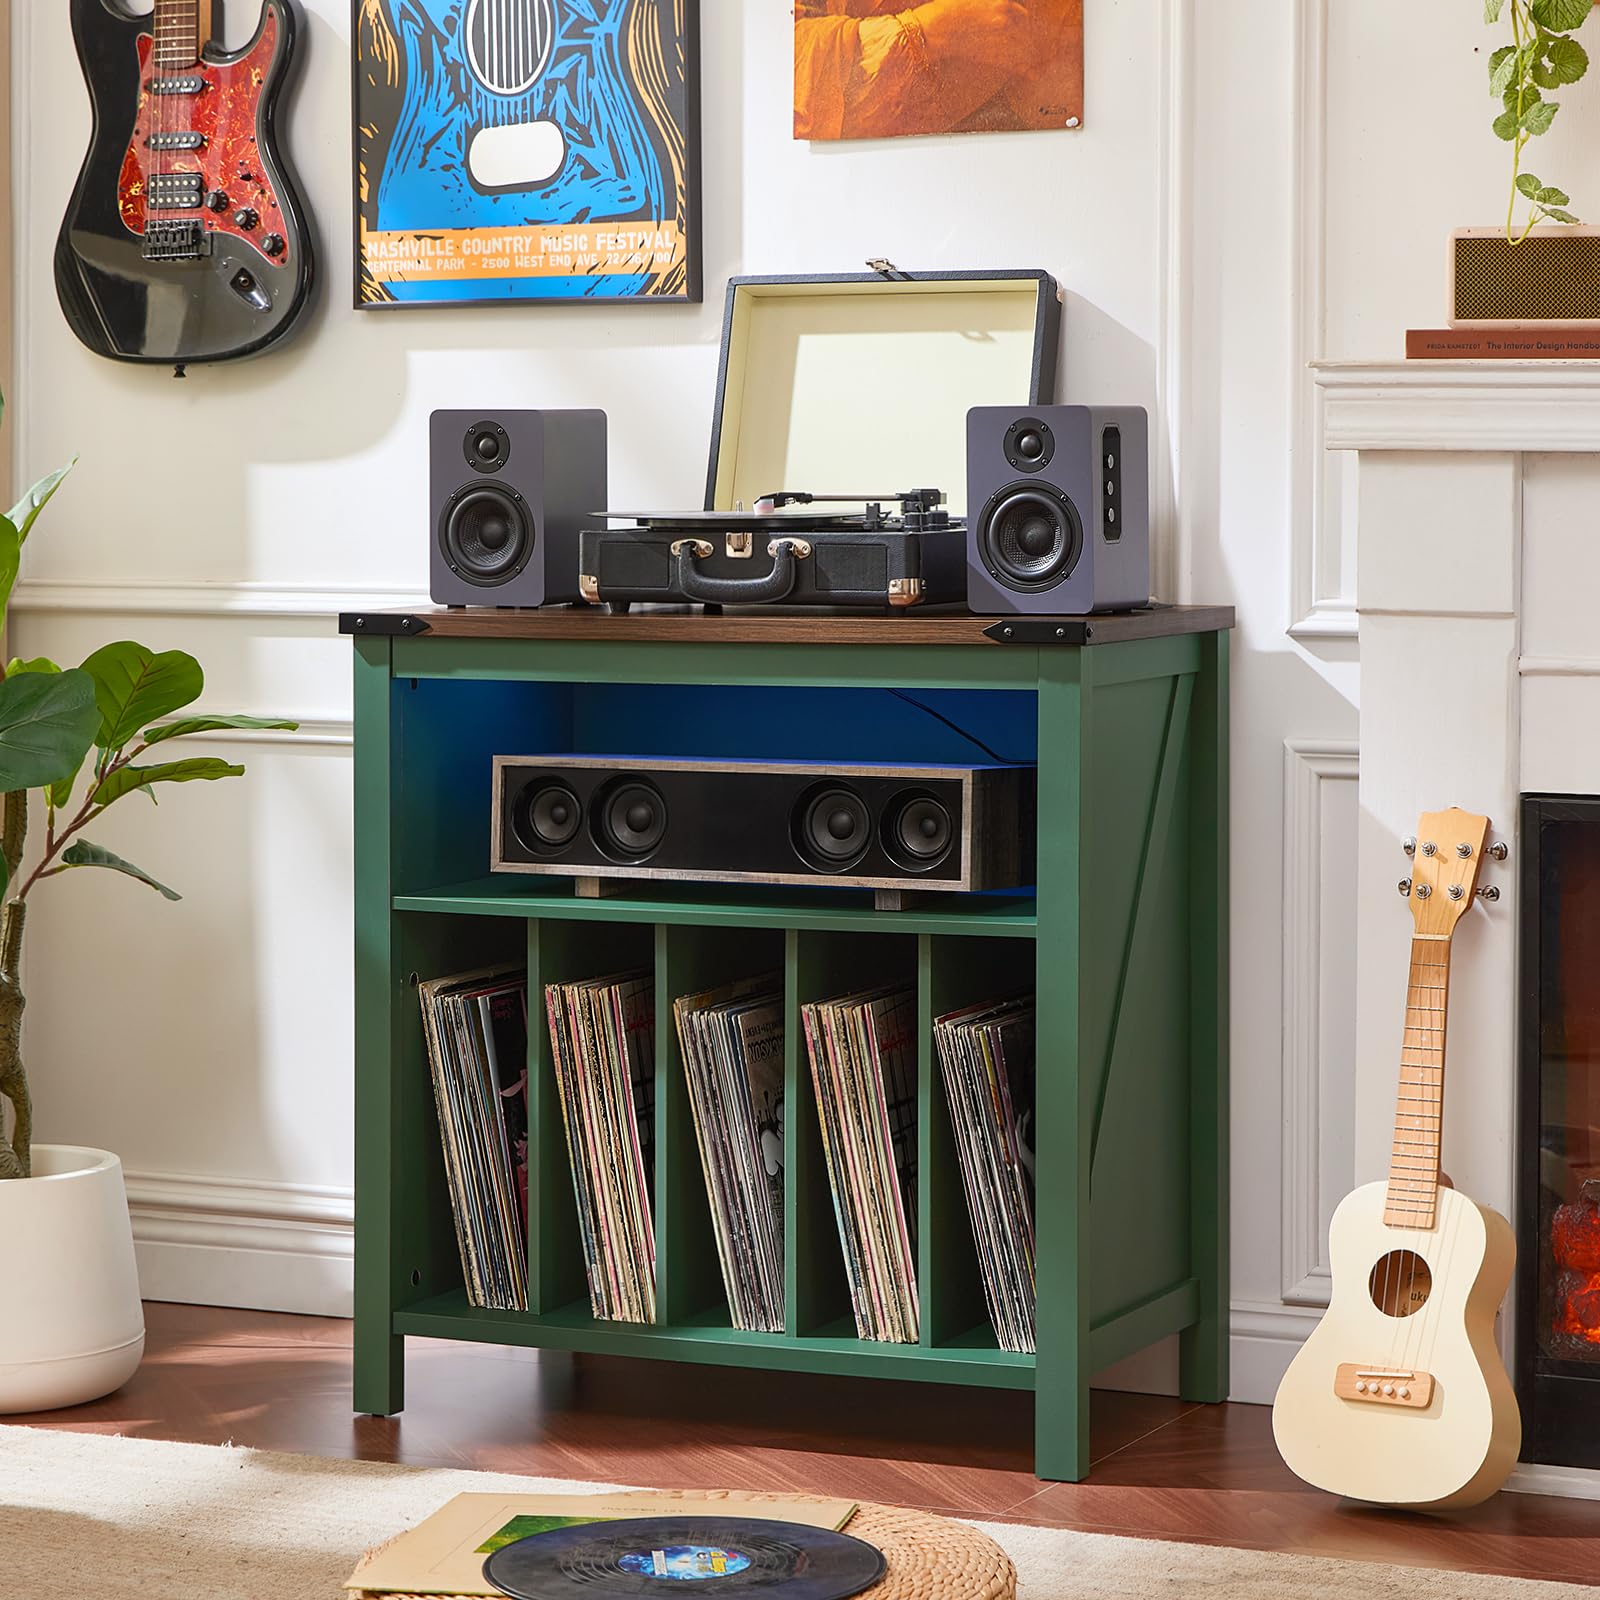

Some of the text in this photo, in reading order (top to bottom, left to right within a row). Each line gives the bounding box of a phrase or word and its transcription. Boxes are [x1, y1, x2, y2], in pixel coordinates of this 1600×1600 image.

[367, 230, 674, 259] NASHVILLE COUNTRY MUSIC FESTIVAL
[368, 258, 432, 273] CENTENNIAL
[437, 257, 465, 271] PARK
[481, 256, 510, 269] 2500
[514, 254, 544, 268] WEST
[549, 253, 571, 267] END
[576, 251, 598, 266] AVE
[1487, 341, 1502, 350] The
[1503, 342, 1534, 350] Interior
[1536, 342, 1564, 352] Design
